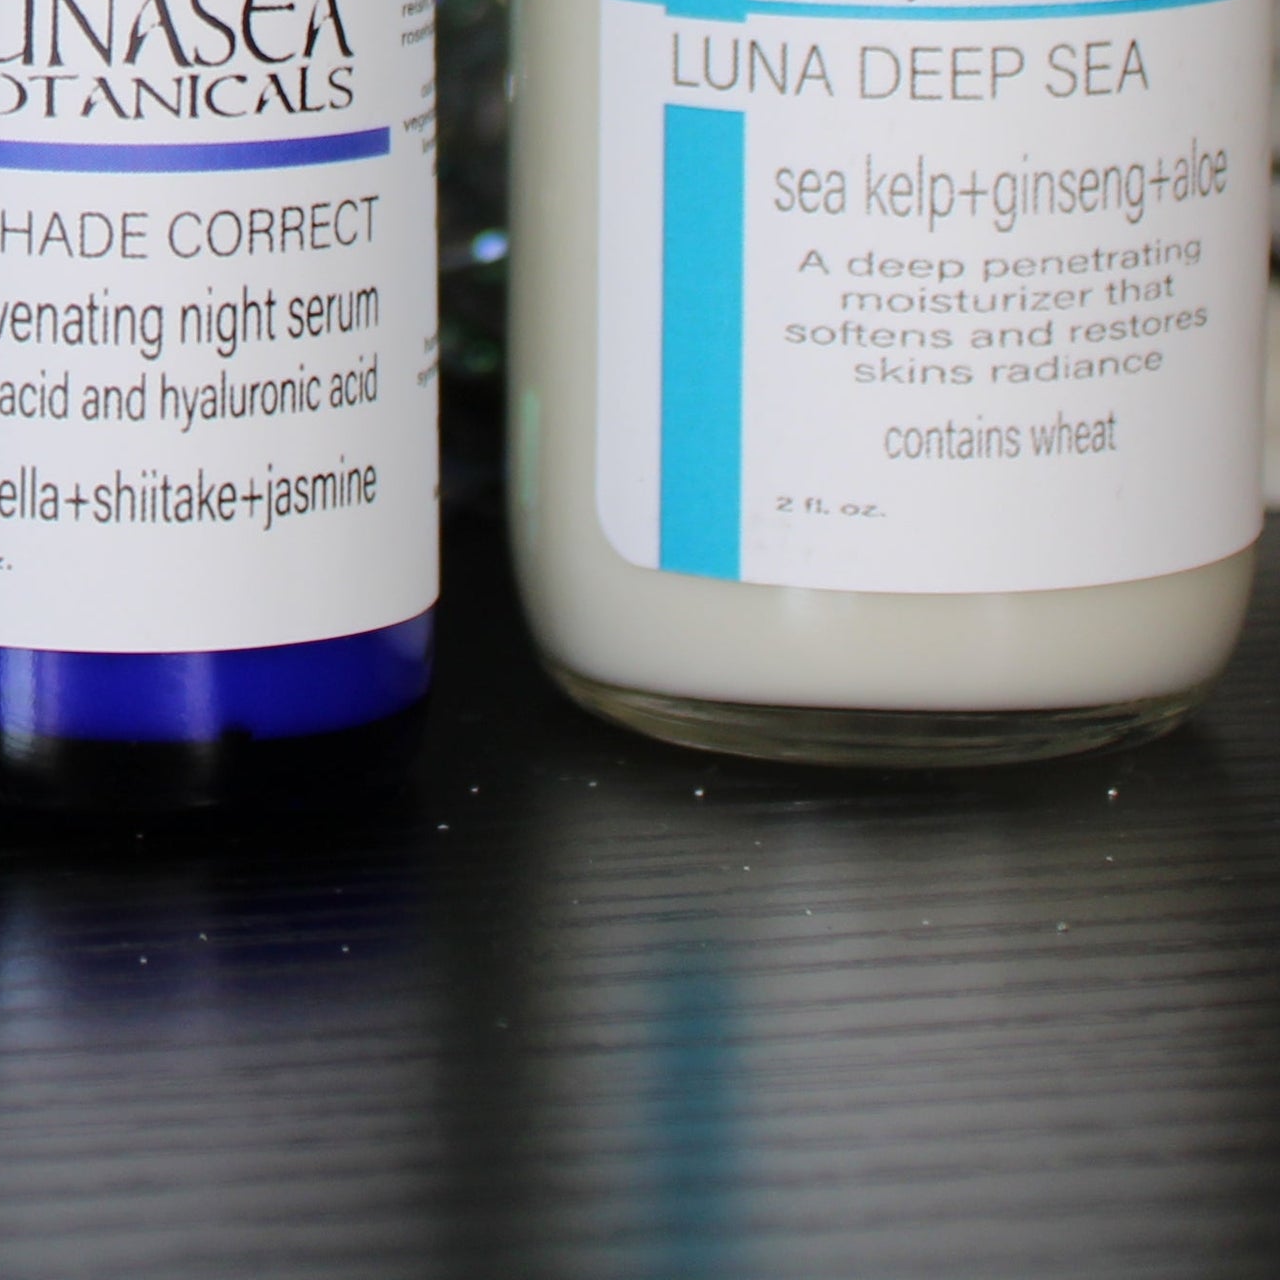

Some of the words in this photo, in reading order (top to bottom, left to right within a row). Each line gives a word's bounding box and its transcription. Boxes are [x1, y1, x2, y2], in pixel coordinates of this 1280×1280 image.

[673, 33, 833, 96] LUNA
[859, 46, 1024, 100] DEEP
[1046, 39, 1148, 98] SEA
[774, 167, 846, 215] sea
[866, 139, 1227, 233] kelp+ginseng+aloe
[168, 195, 379, 259] CORRECT
[799, 250, 829, 274] A
[848, 251, 965, 283] deep
[983, 239, 1201, 283] penetrating
[842, 286, 1092, 313] moisturizer
[1106, 275, 1173, 305] that
[180, 284, 277, 359] night
[287, 286, 379, 339] serum
[786, 321, 952, 348] softens
[971, 320, 1053, 349] and
[1070, 302, 1207, 342] restores
[855, 357, 973, 384] skins
[992, 352, 1162, 383] radiance
[81, 372, 146, 422] and
[160, 363, 321, 434] hyaluronic
[329, 352, 377, 409] acid
[885, 416, 1020, 460] contains
[1031, 412, 1116, 456] wheat
[777, 497, 792, 511] 2
[805, 498, 829, 514] fl.
[841, 503, 886, 518] oz.
